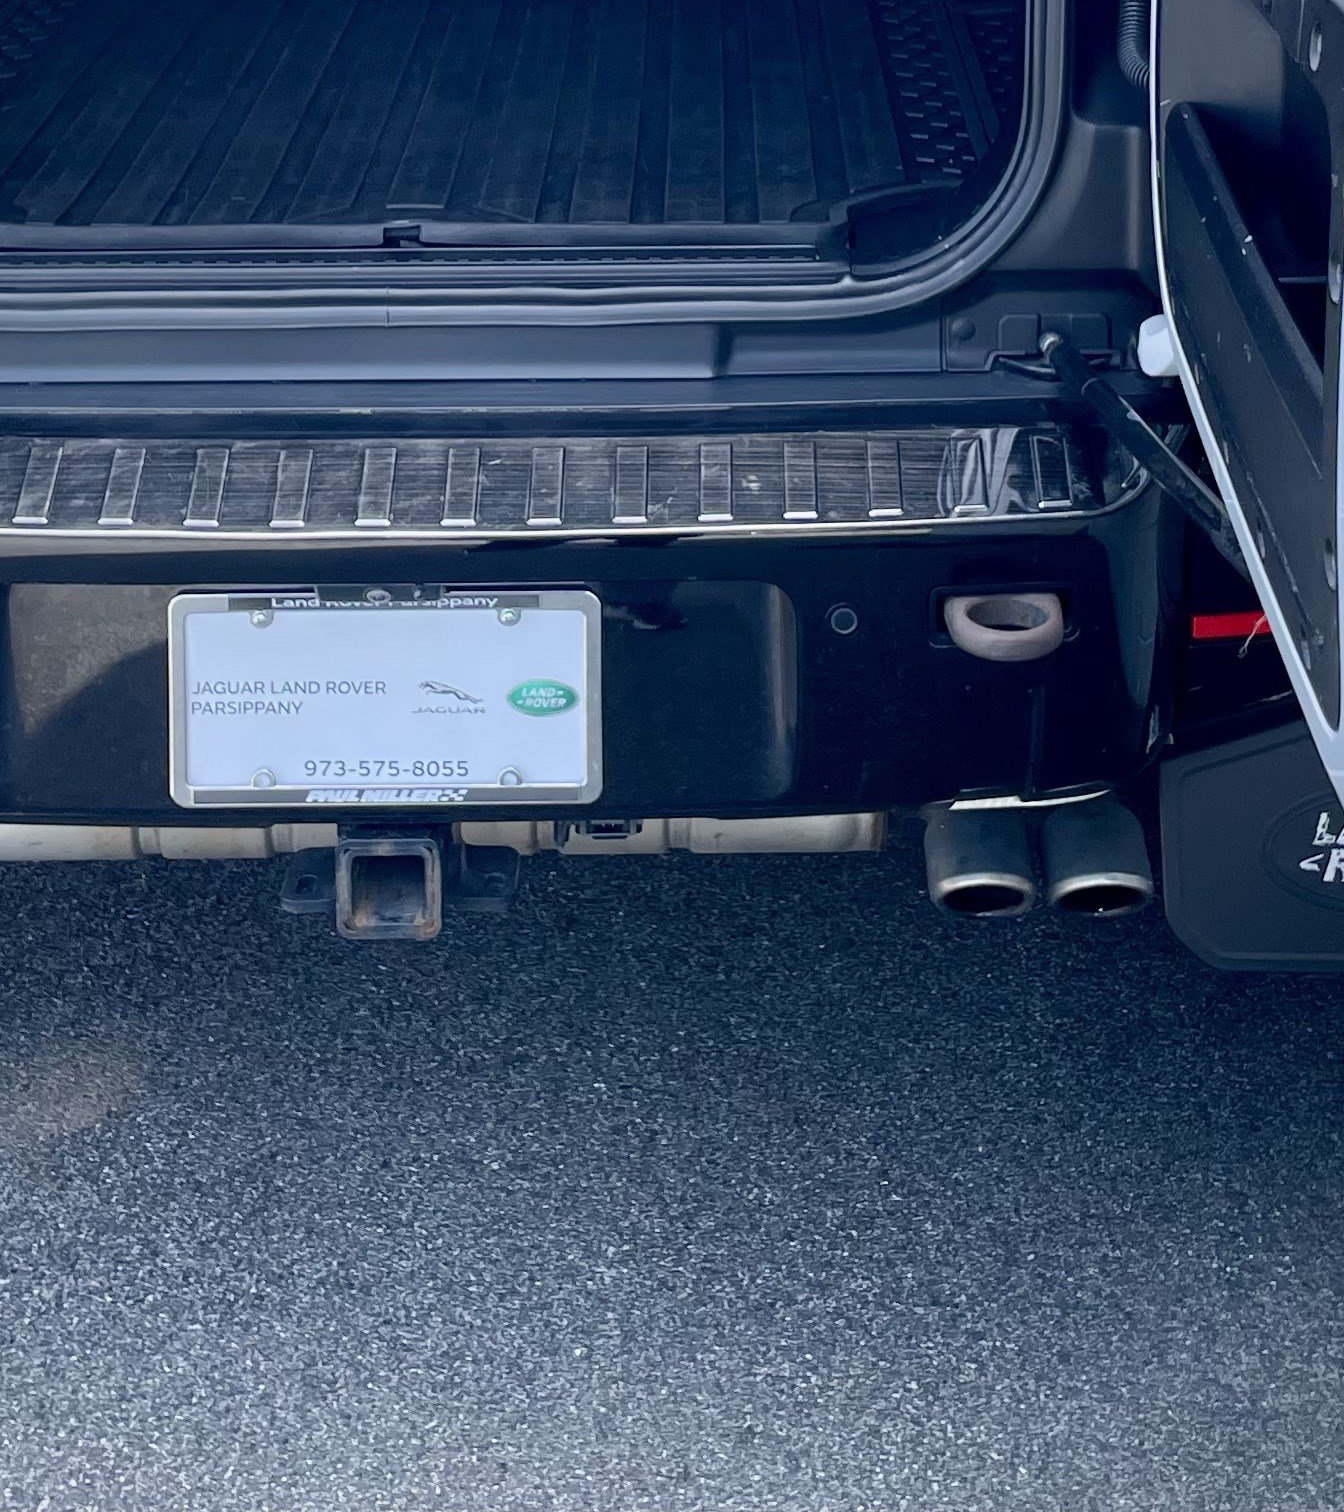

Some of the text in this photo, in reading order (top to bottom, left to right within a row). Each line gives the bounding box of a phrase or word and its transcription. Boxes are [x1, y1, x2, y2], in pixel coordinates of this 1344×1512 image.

[271, 596, 321, 608] Land
[192, 680, 388, 696] JAGUAR LAND ROVER
[521, 686, 556, 698] LAND
[191, 700, 304, 716] PARSIPPANY
[411, 705, 486, 714] JAGUAR
[524, 697, 567, 709] ROVER
[303, 759, 470, 778] 973-575-8055
[305, 788, 441, 803] PAUL MILLER
